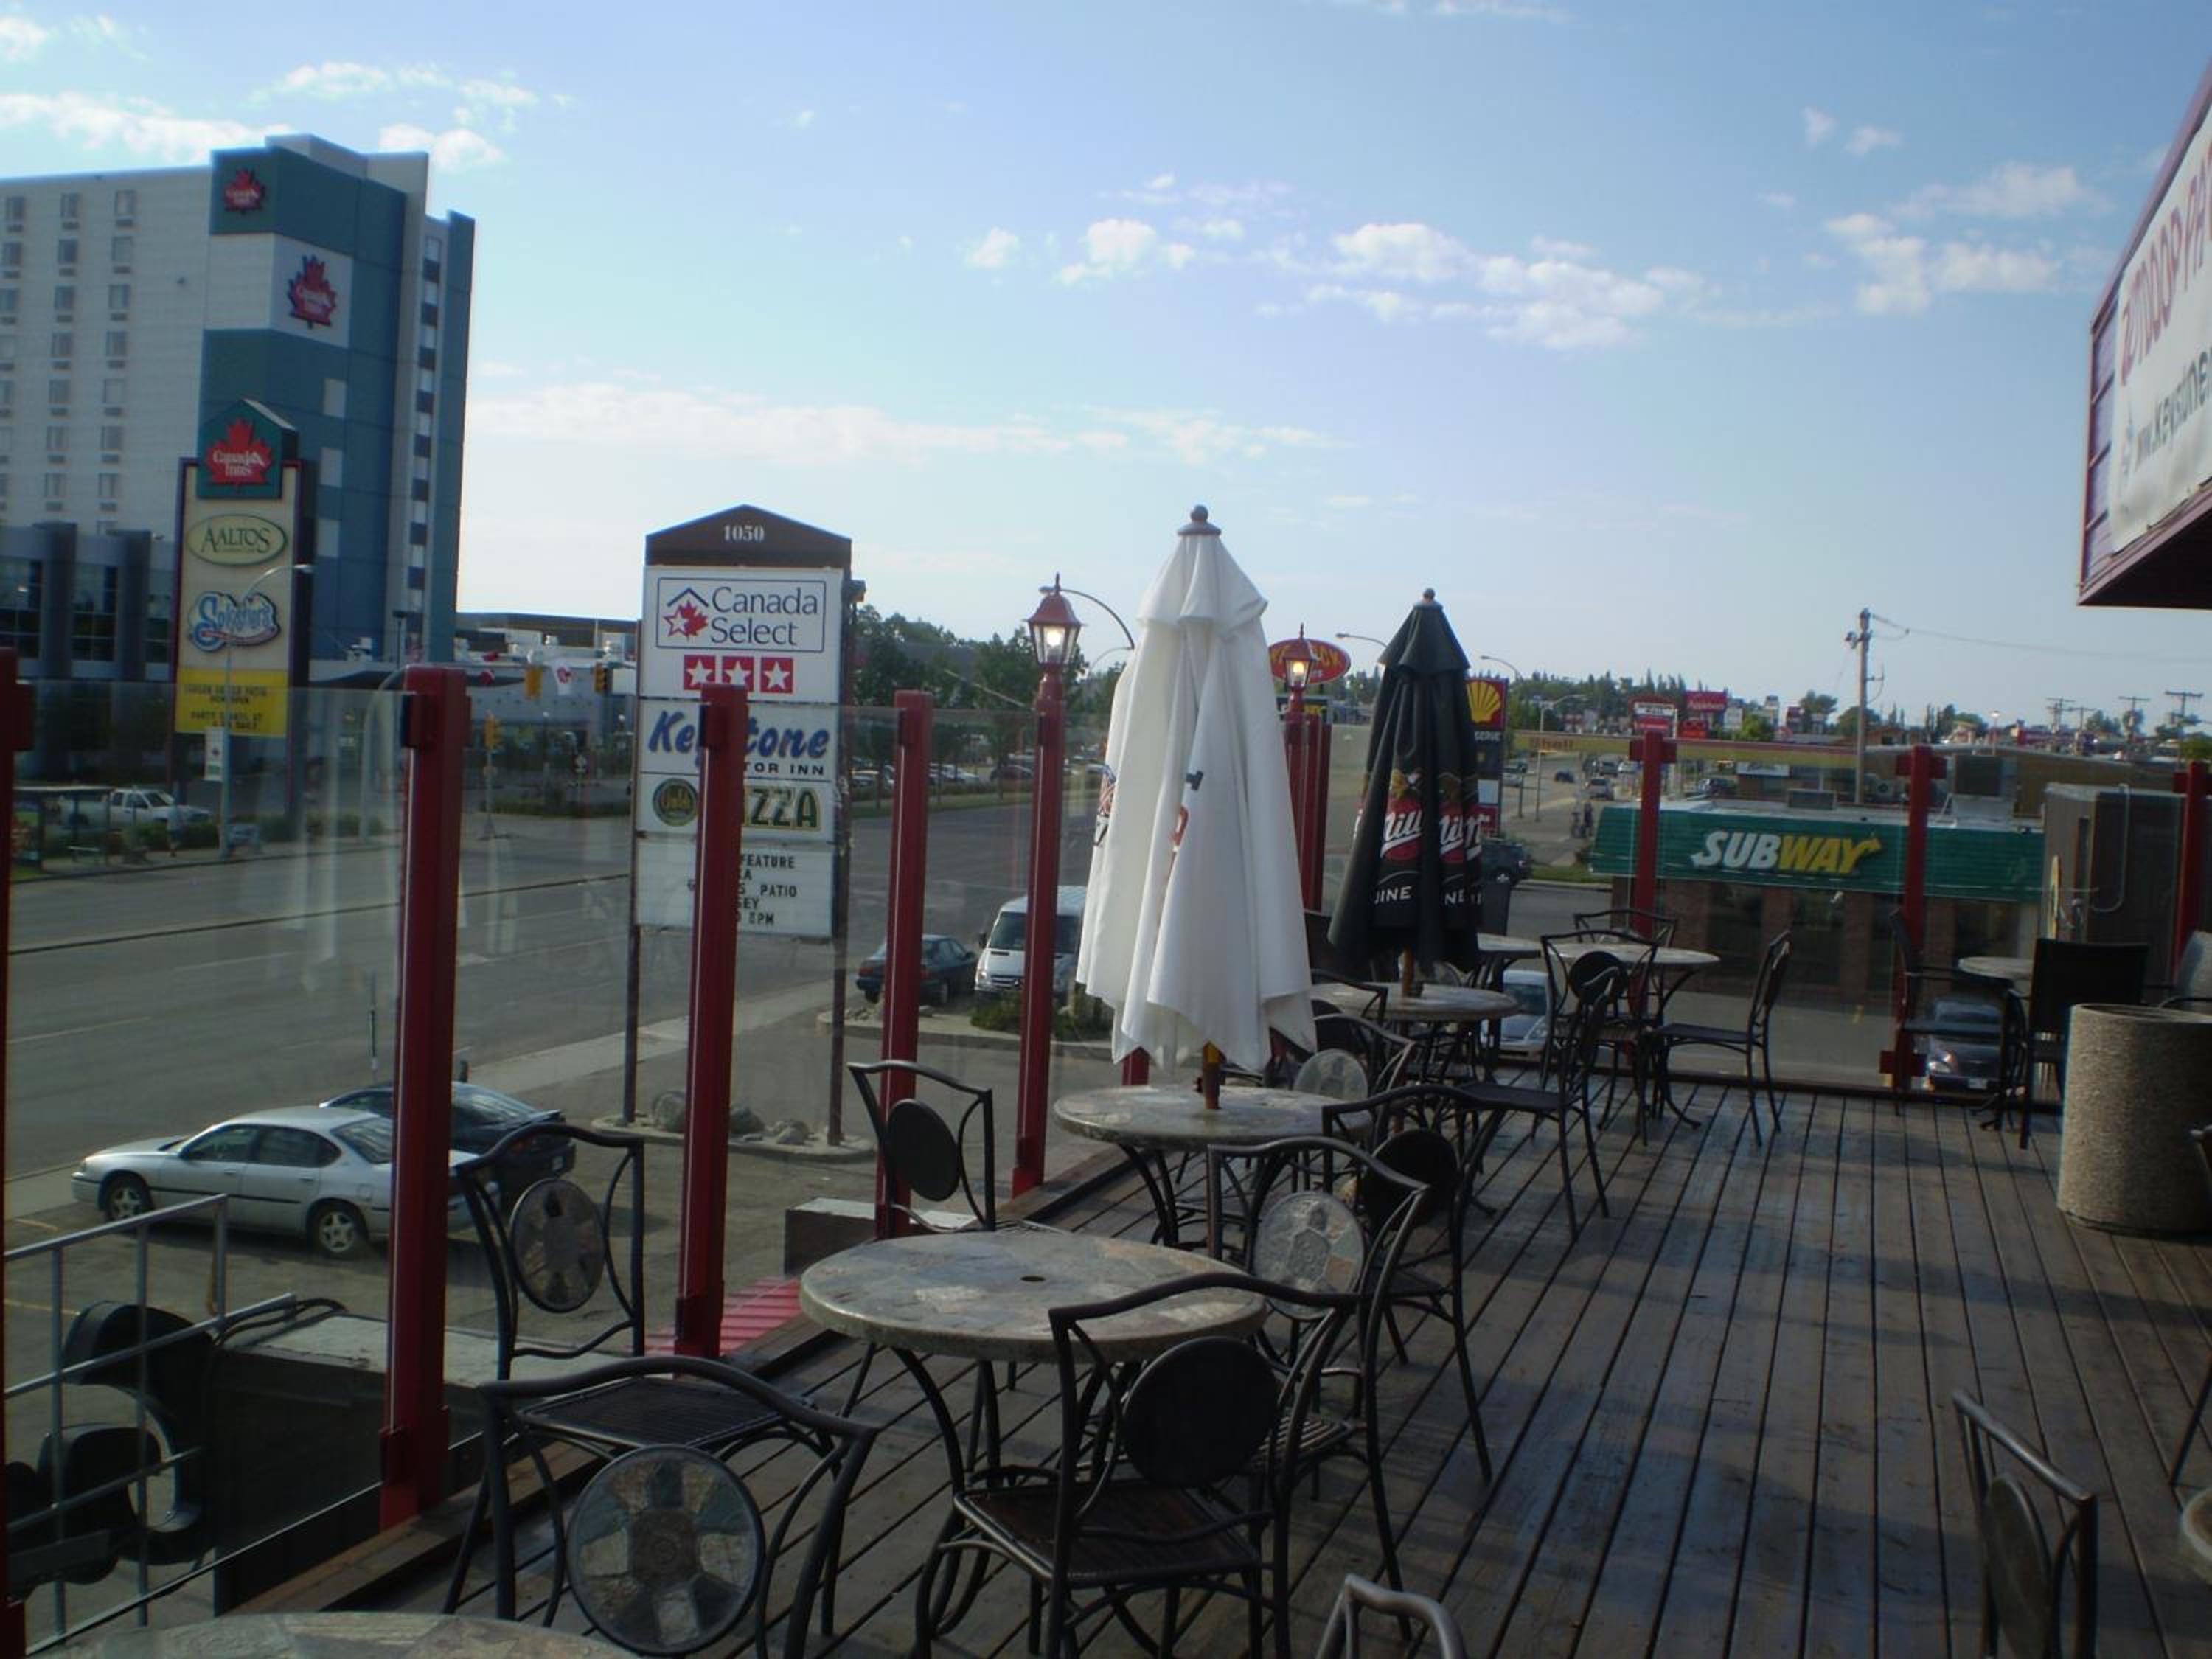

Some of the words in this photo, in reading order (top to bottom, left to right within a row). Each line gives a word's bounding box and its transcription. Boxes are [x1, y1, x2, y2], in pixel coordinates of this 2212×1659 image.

[201, 526, 271, 554] AALTOS
[723, 524, 765, 542] 1050
[712, 586, 818, 615] Canada
[710, 616, 799, 646] Select
[647, 710, 830, 768] Ketone
[790, 764, 824, 774] INN
[750, 787, 818, 827] ZZA
[1690, 830, 1880, 874] SUBWAY
[760, 884, 797, 897] PATIO
